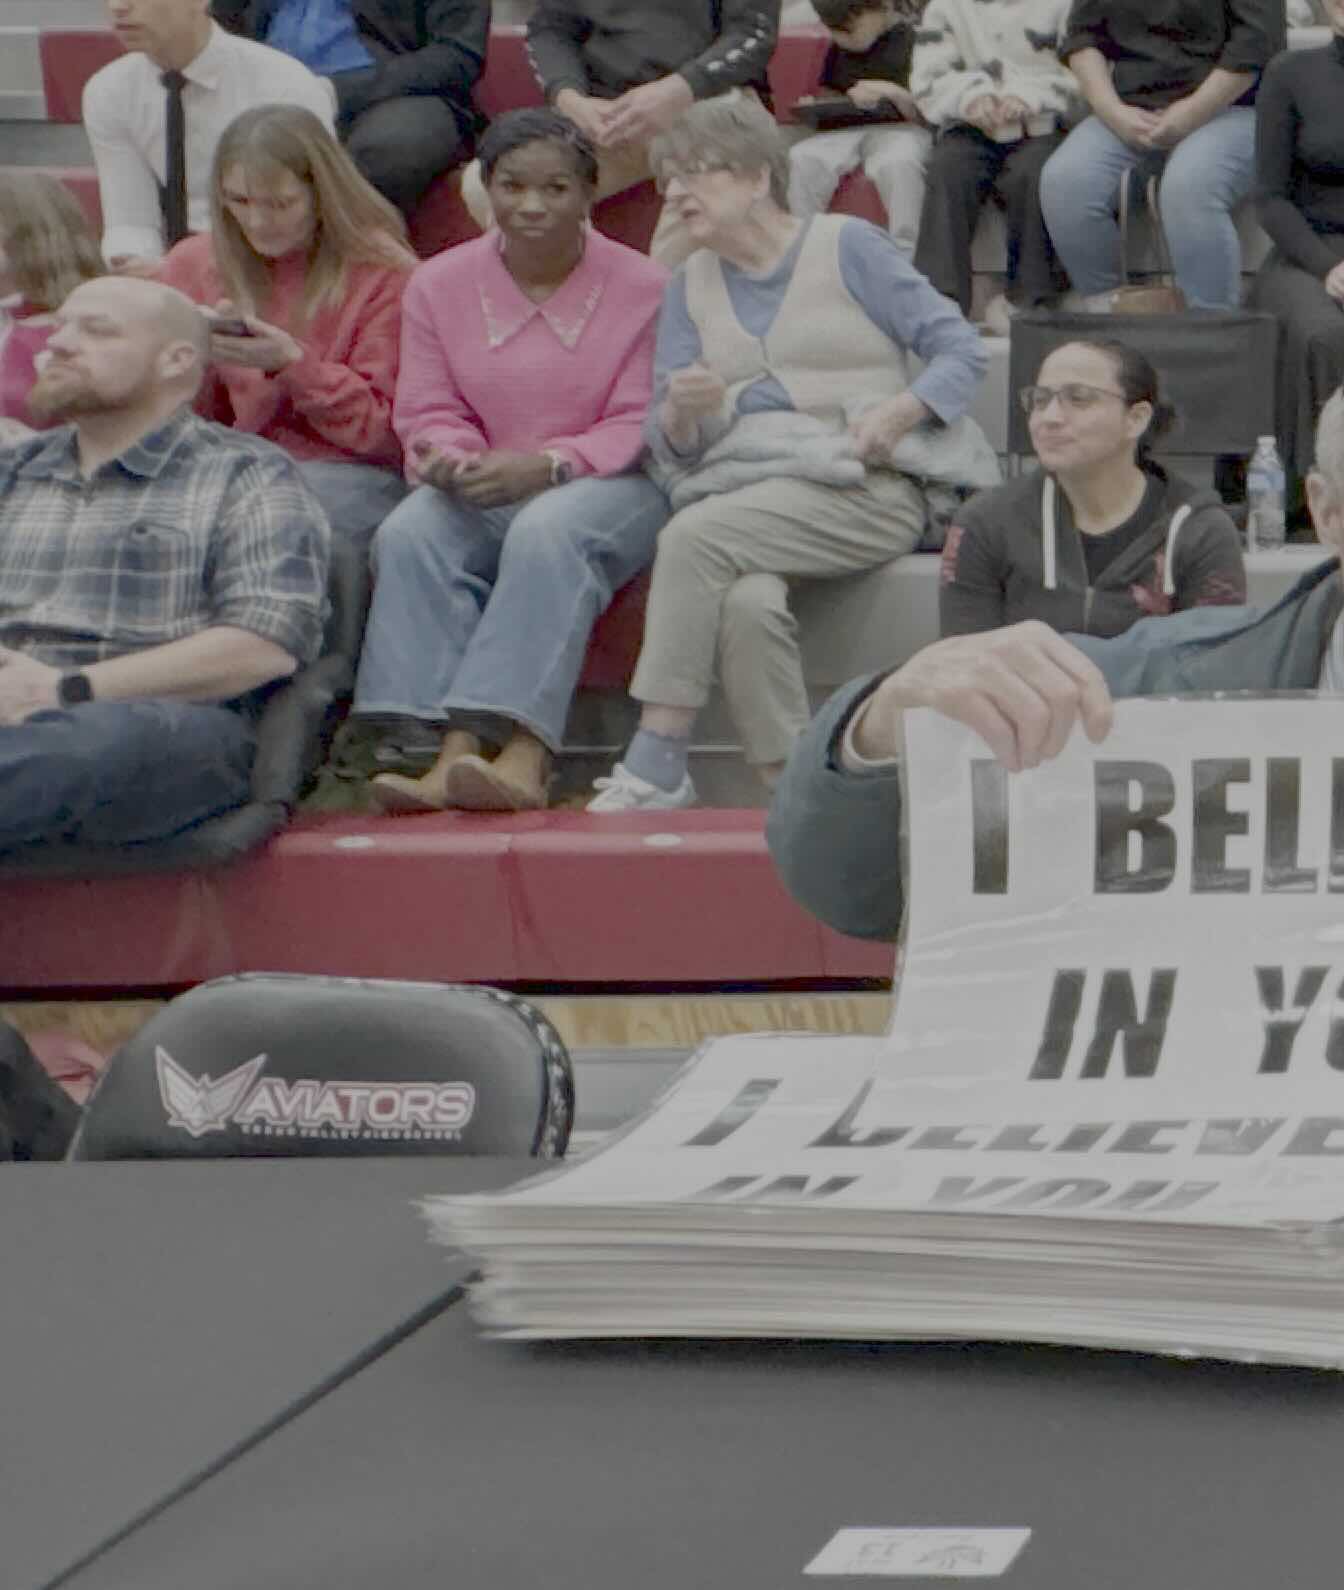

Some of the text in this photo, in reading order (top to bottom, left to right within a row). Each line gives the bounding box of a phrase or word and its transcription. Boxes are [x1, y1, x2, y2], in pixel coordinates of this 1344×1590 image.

[971, 759, 1010, 895] I
[1029, 968, 1178, 1081] IN
[236, 1079, 473, 1129] AVIATORS
[682, 1078, 782, 1146] I
